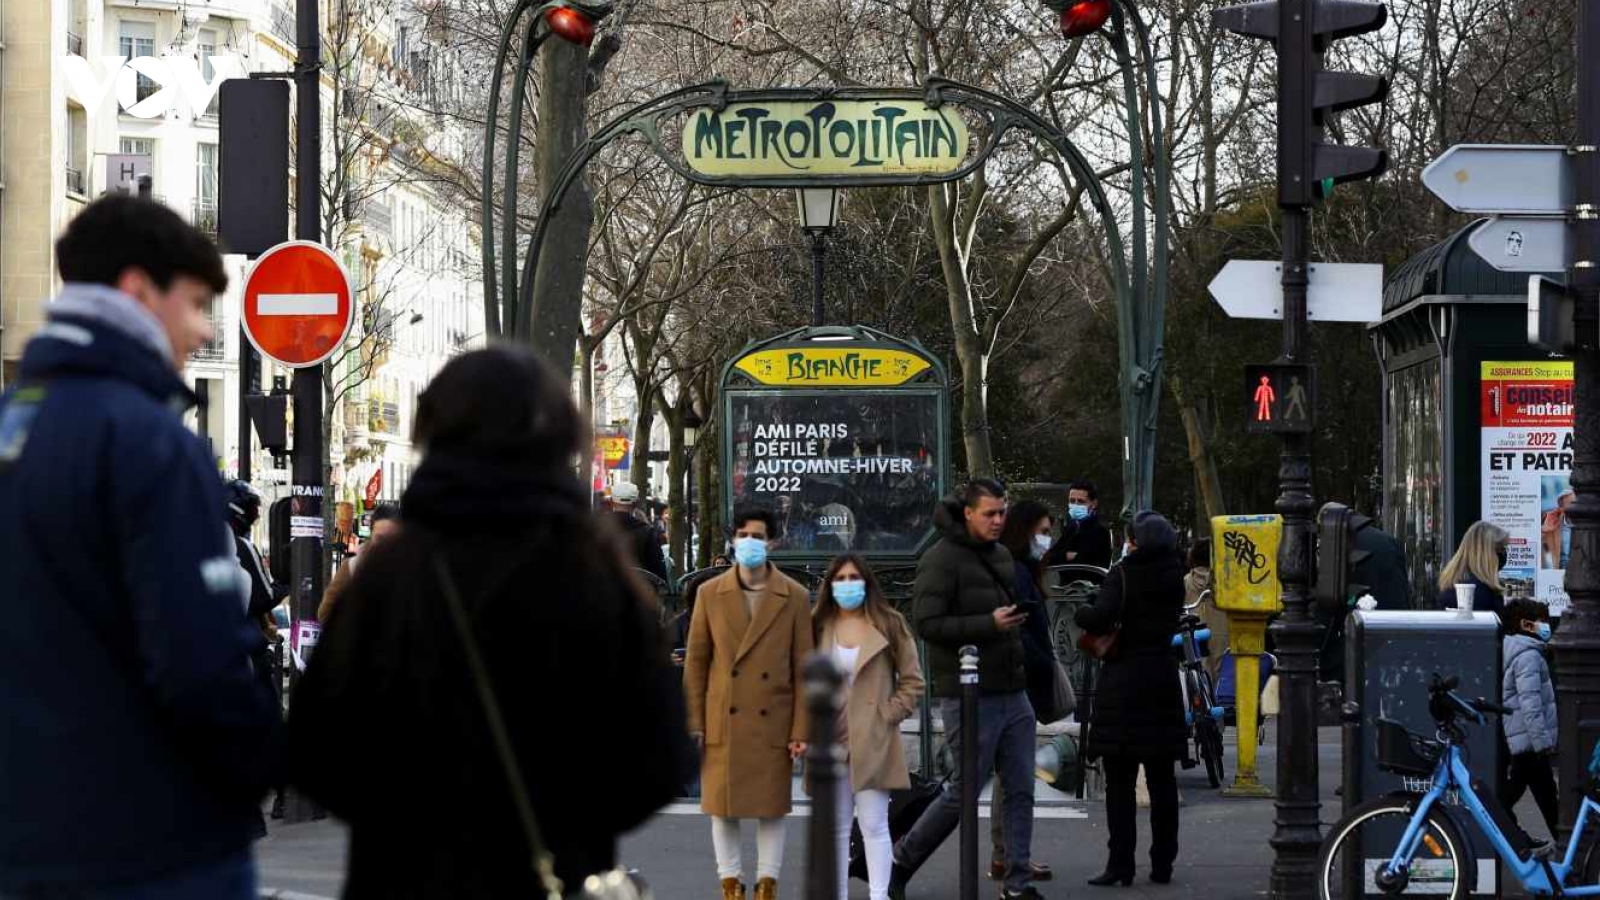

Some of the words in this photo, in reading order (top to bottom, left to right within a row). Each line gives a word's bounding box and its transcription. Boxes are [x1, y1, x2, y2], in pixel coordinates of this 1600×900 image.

[695, 103, 957, 170] METROPOLITAIN
[786, 352, 882, 380] BLANCHE
[755, 424, 789, 438] AMI
[795, 423, 848, 439] PARIS
[1527, 432, 1557, 447] 2022
[755, 440, 817, 456] DÉFILÉ
[755, 459, 912, 474] AUTOMNE-HIVER
[1491, 453, 1516, 470] ET
[1523, 453, 1573, 470] PATR
[755, 478, 801, 492] 2022
[819, 511, 848, 527] ami
